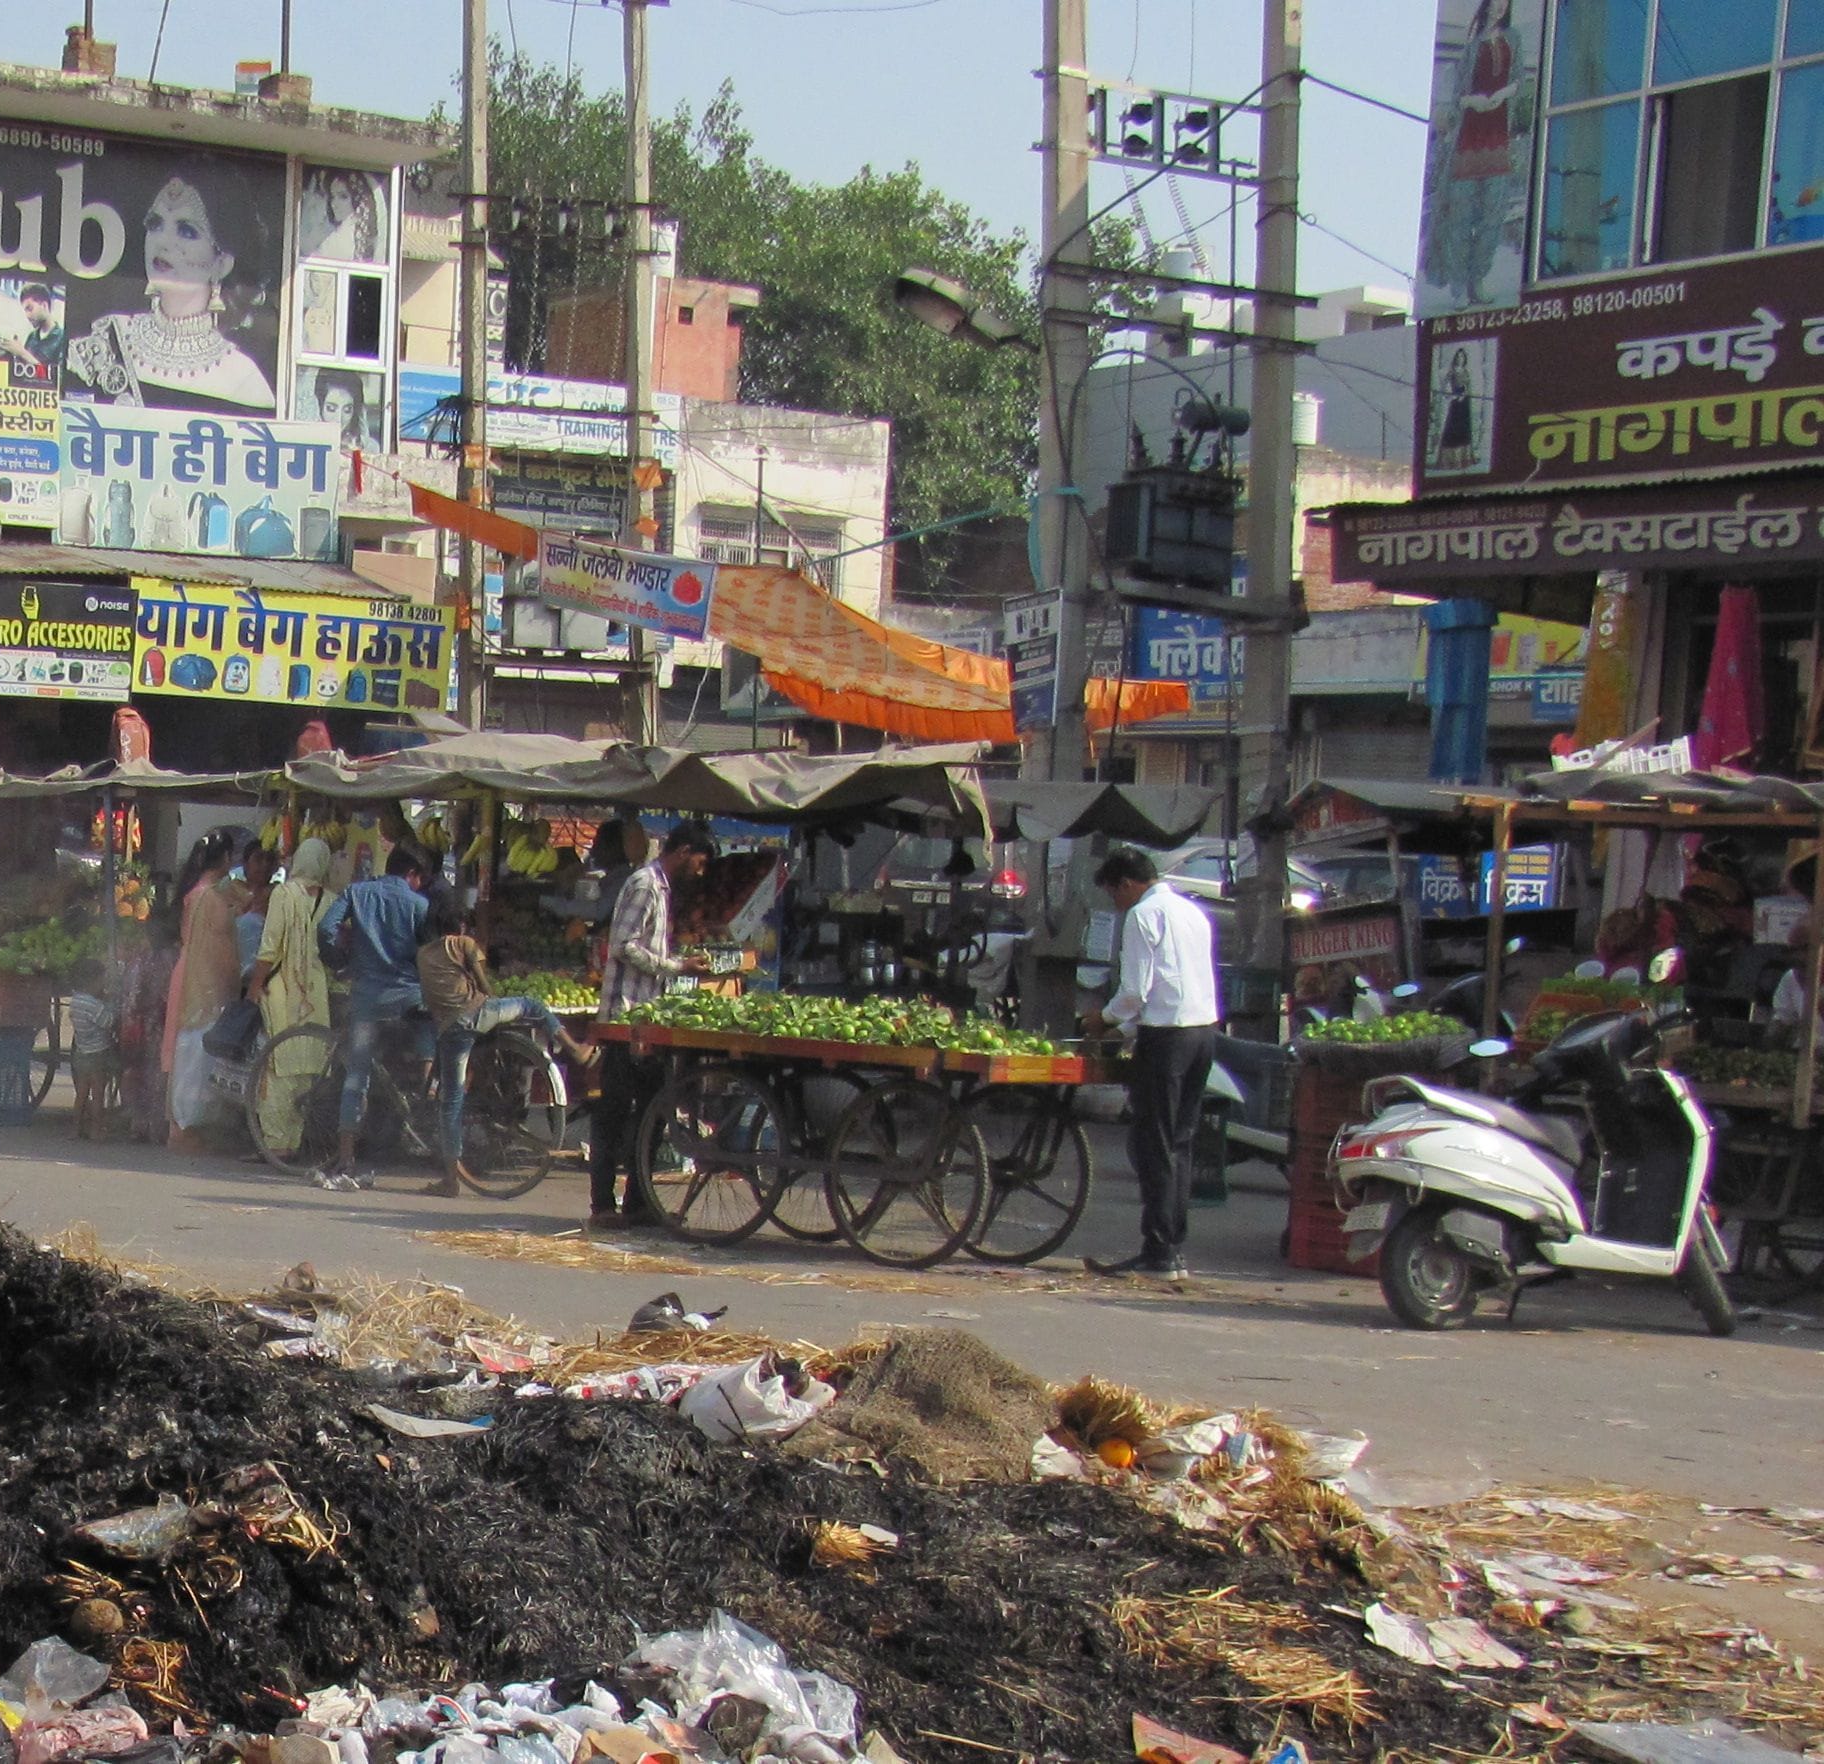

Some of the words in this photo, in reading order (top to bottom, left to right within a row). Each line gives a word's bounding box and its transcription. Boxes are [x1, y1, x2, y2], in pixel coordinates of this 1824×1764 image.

[1572, 282, 1687, 318] 98120-00501
[1616, 306, 1786, 383] कपड़े
[556, 418, 622, 441] TRAINING
[60, 405, 160, 481] बैग
[168, 419, 234, 486] ही
[236, 420, 333, 493] बैग
[1356, 521, 1545, 568] नागपाल
[1551, 492, 1808, 558] टैक्सटाईल
[137, 584, 229, 651] योग
[315, 612, 446, 670] हाऊस
[368, 600, 404, 619] 98138
[407, 604, 443, 623] 42801
[27, 619, 132, 653] ACCESSORIES
[1356, 917, 1394, 949] KING
